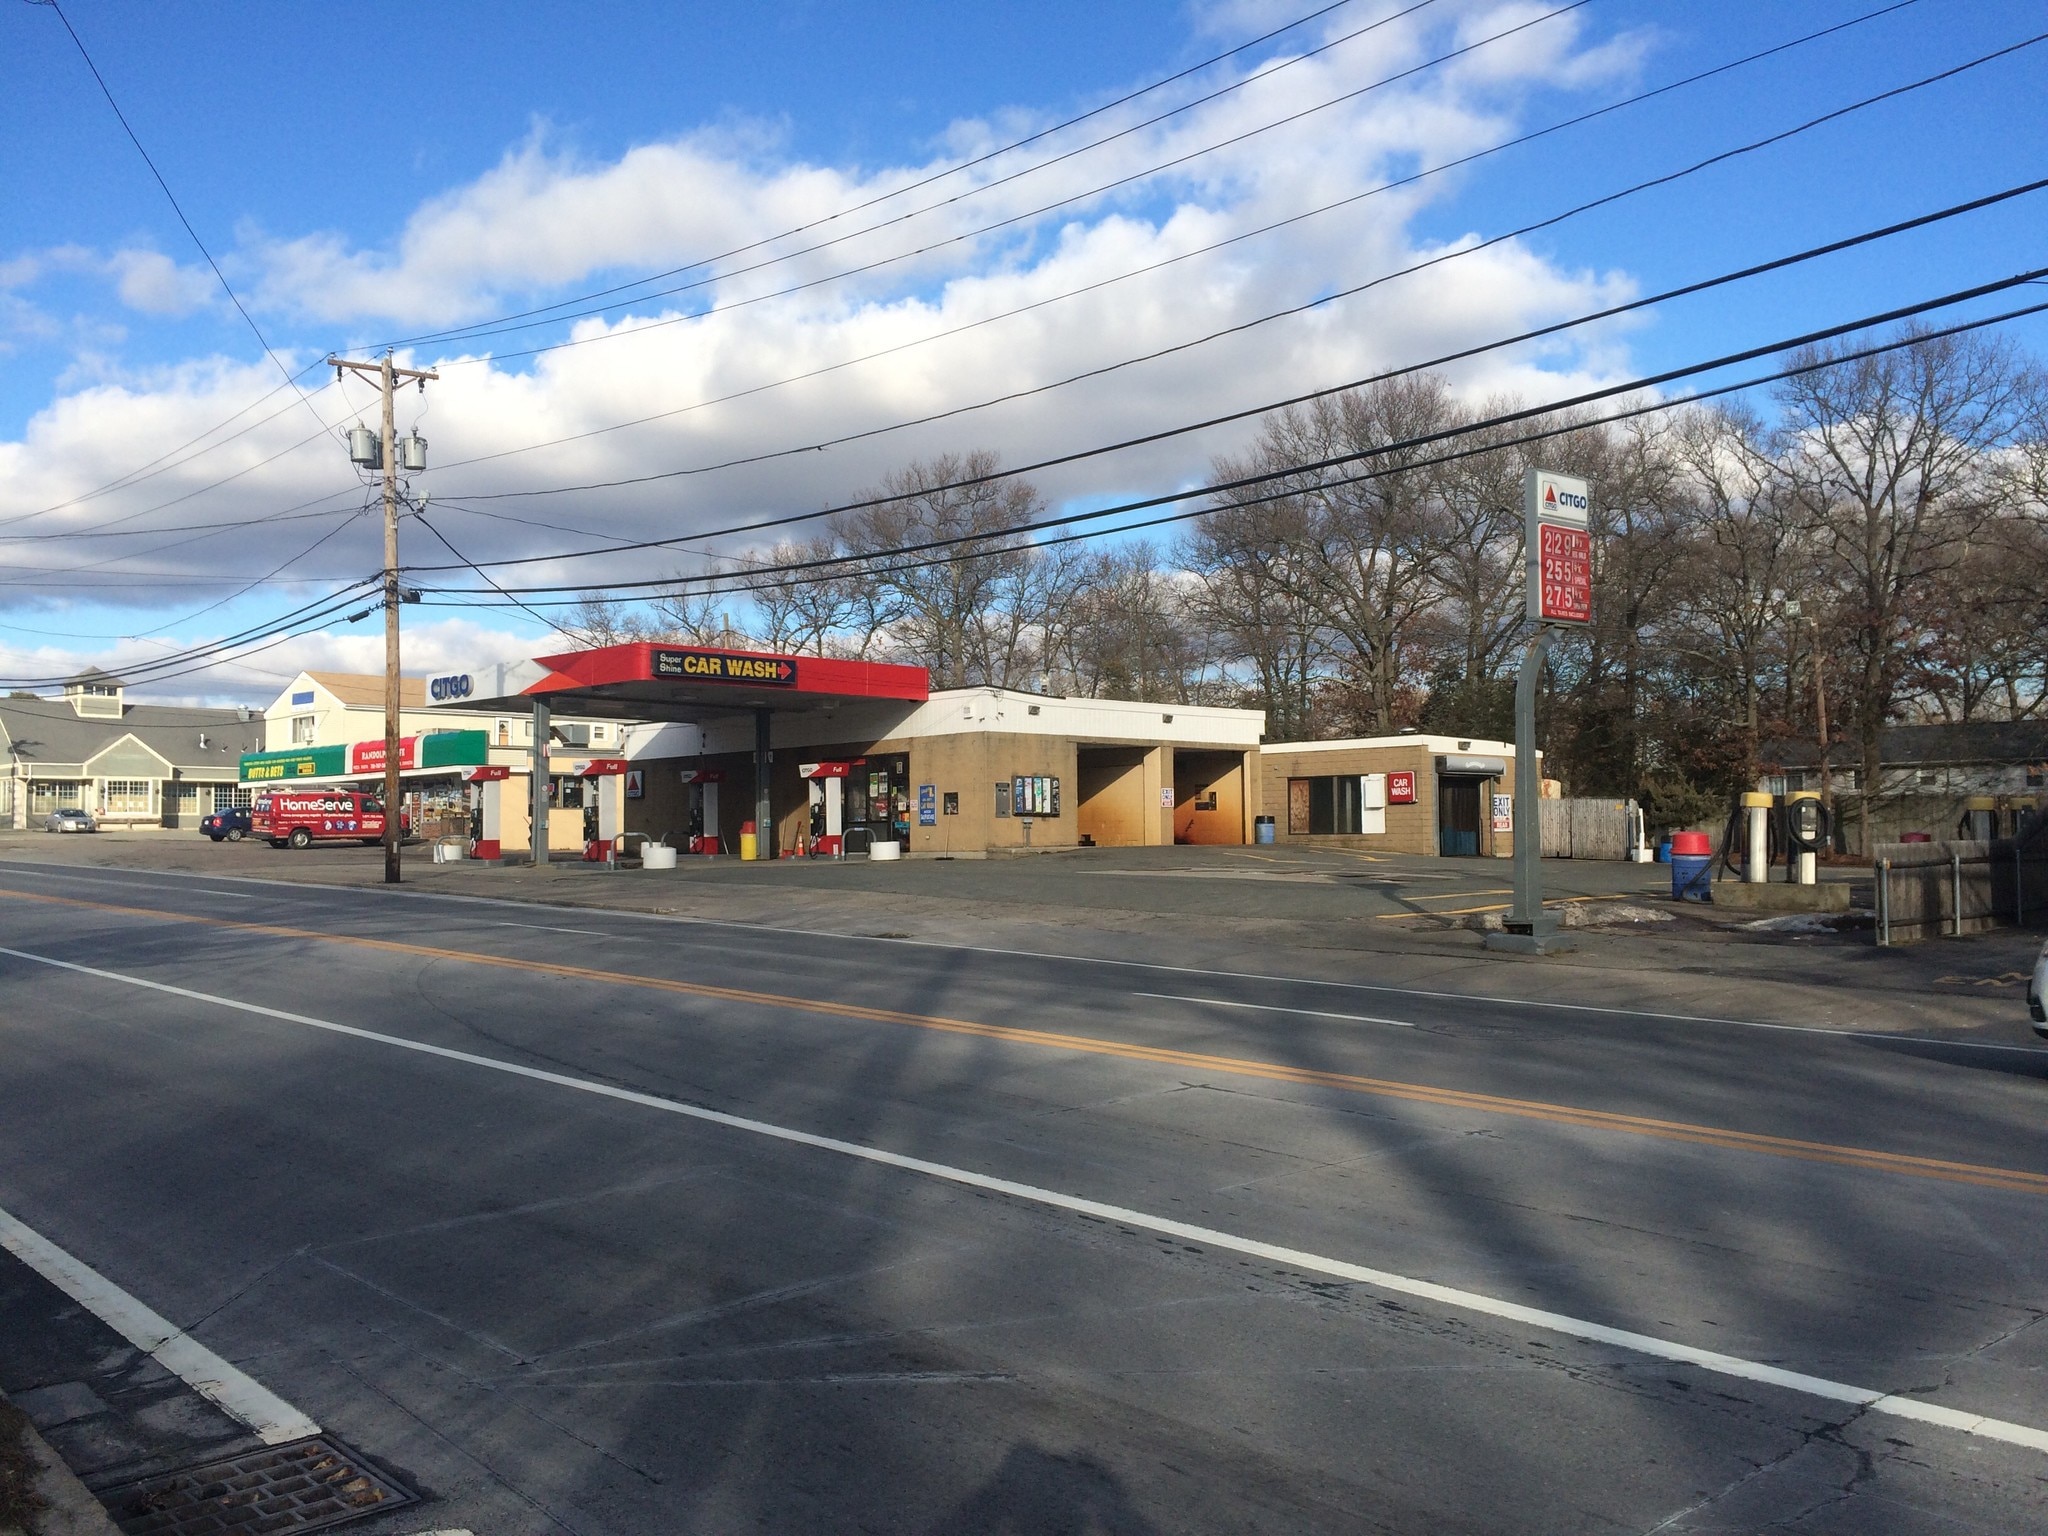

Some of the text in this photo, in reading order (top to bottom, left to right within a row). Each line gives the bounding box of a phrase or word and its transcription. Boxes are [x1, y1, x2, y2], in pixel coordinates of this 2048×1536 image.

[1559, 492, 1587, 509] CITGO
[1545, 531, 1572, 556] 229
[1546, 559, 1572, 582] 255
[1545, 585, 1573, 608] 275
[659, 653, 682, 664] Super
[659, 663, 682, 674] Shine
[684, 655, 777, 679] CAR WASH
[431, 674, 472, 700] CITGO
[361, 750, 388, 760] RANDOLP
[1393, 778, 1408, 787] CAR
[1391, 787, 1411, 796] WASH
[280, 798, 354, 811] HomeServe
[1493, 797, 1510, 807] EXIT
[1493, 807, 1511, 817] ONLY
